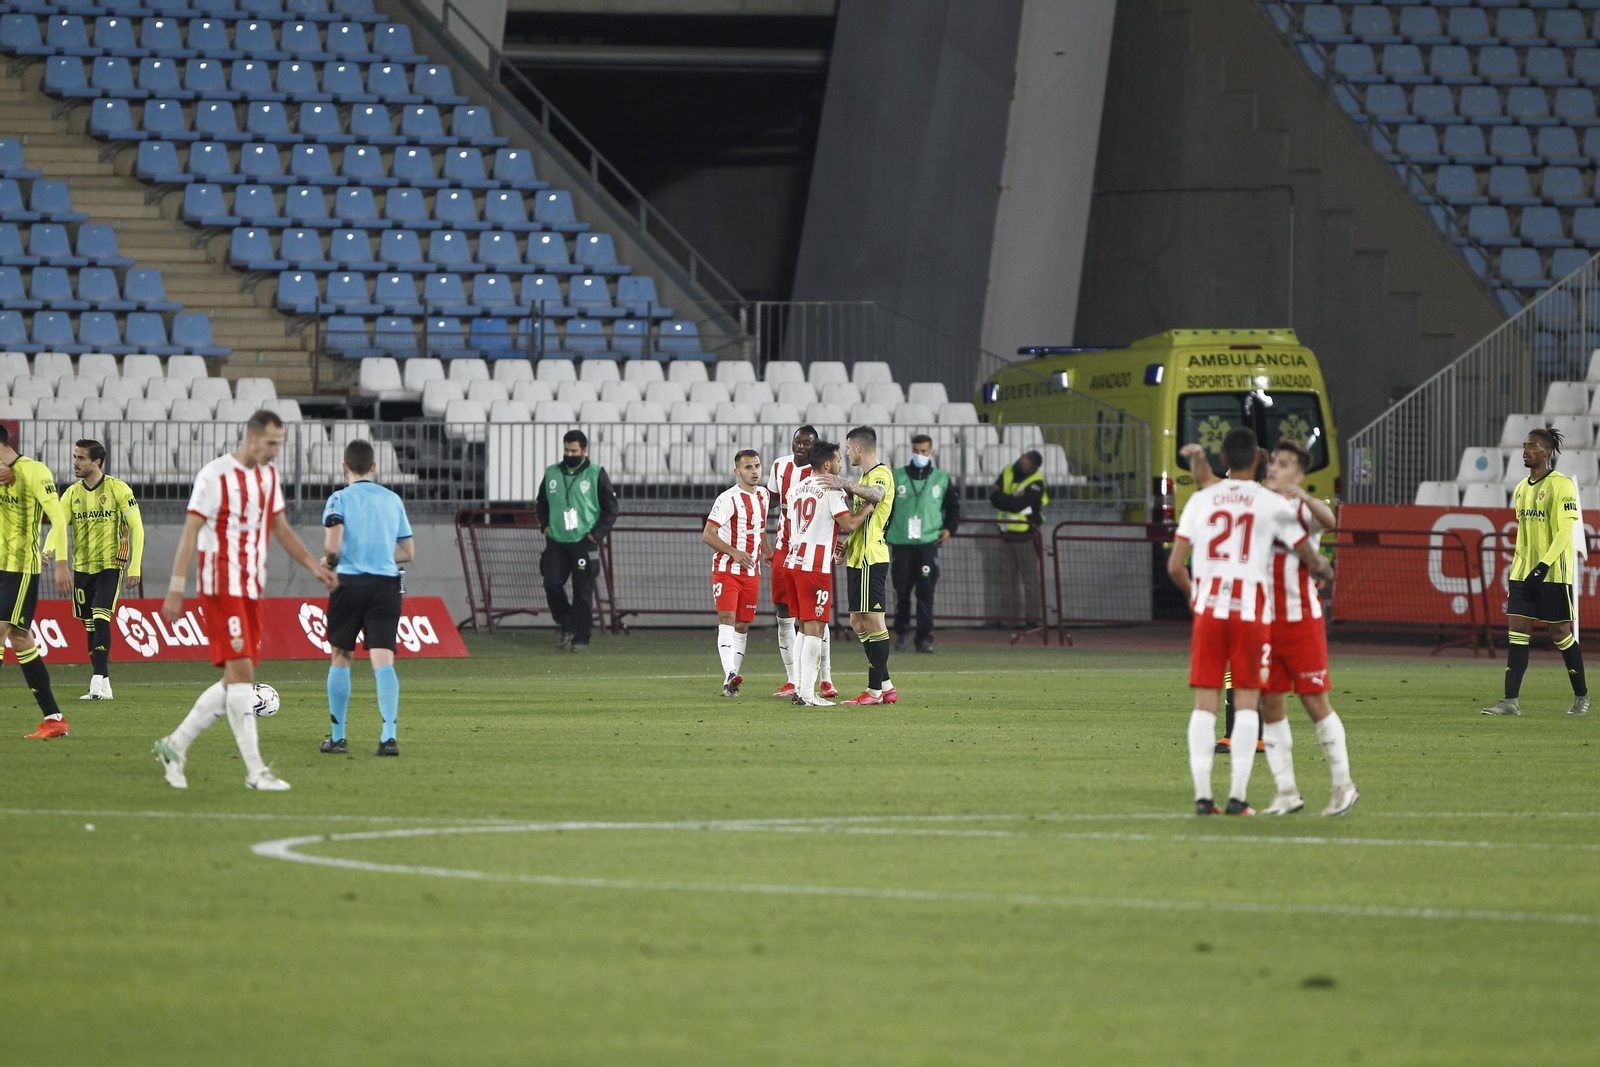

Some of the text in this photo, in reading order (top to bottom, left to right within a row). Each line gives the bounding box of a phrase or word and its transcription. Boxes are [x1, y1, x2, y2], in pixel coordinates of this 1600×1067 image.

[1188, 353, 1308, 367] AMBULANCIA
[1187, 374, 1234, 388] SOPORTE
[795, 485, 824, 500] CARVALHO
[1213, 493, 1254, 506] CHUMI
[73, 510, 112, 520] CARAVAN
[794, 497, 817, 535] 19
[1207, 510, 1255, 563] 21
[816, 589, 829, 605] 19
[228, 616, 241, 637] 8
[1261, 643, 1272, 667] 2
